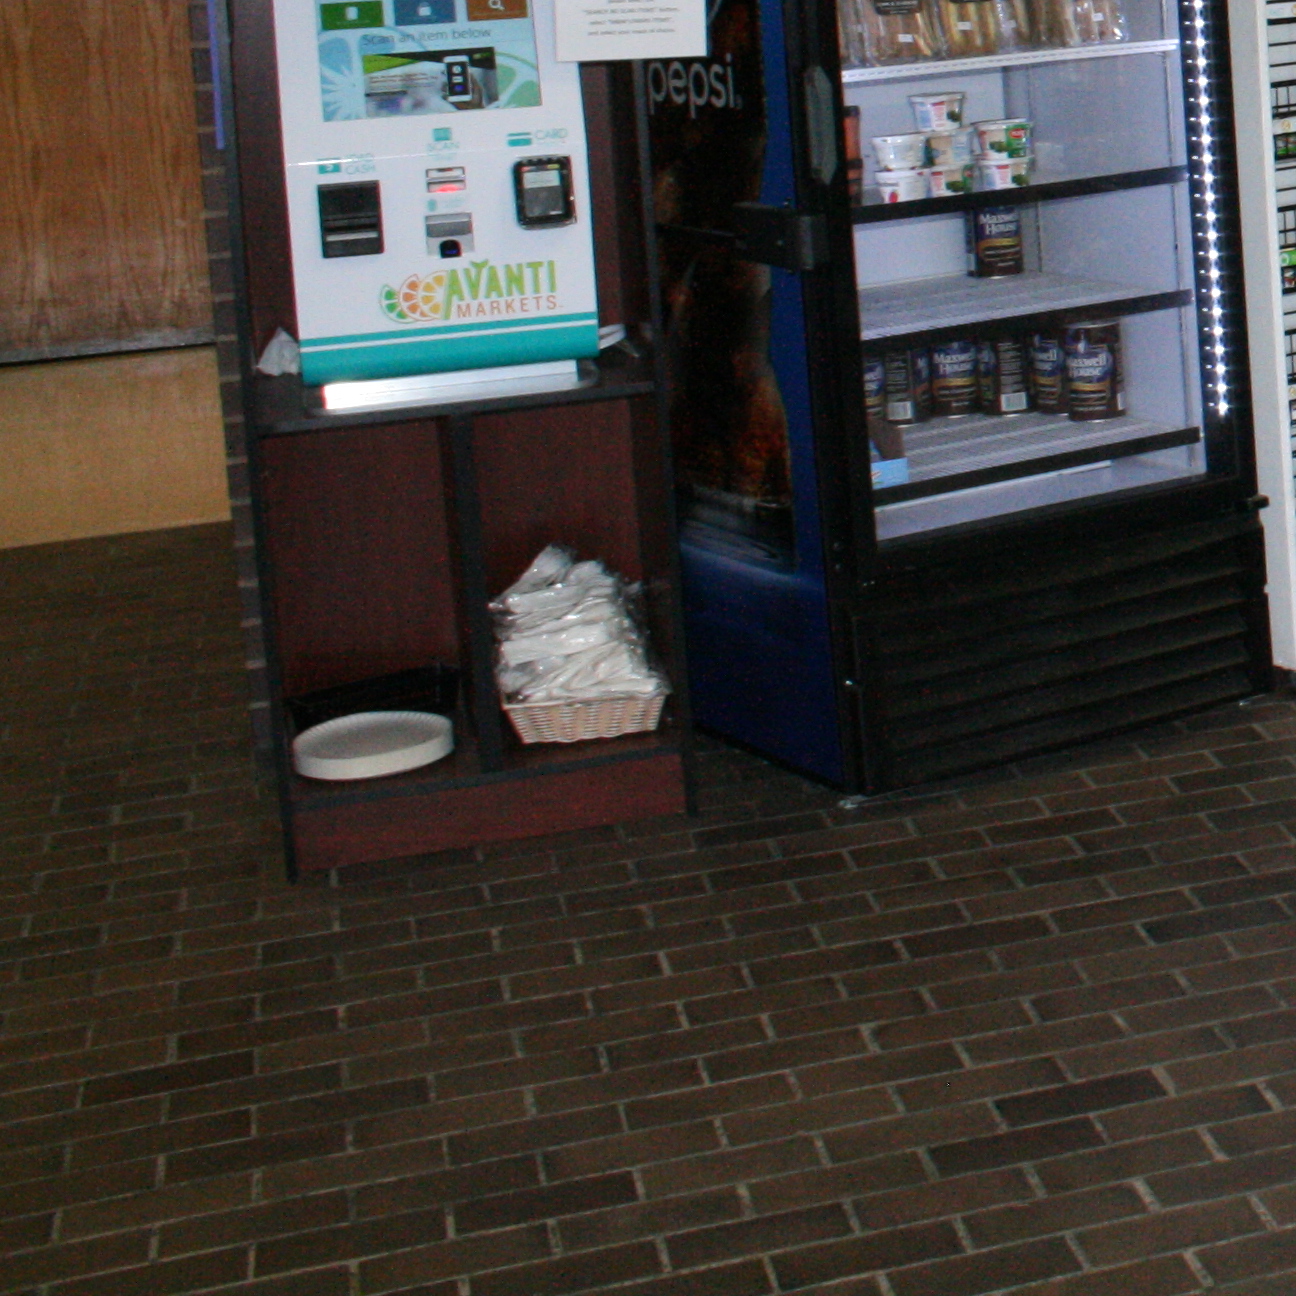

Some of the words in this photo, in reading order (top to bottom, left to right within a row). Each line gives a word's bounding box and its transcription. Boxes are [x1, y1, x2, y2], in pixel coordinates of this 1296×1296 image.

[452, 27, 492, 40] below
[649, 53, 735, 119] pepsi
[535, 128, 569, 141] CARD
[448, 259, 557, 303] AVANTI
[457, 294, 560, 319] MARKETS
